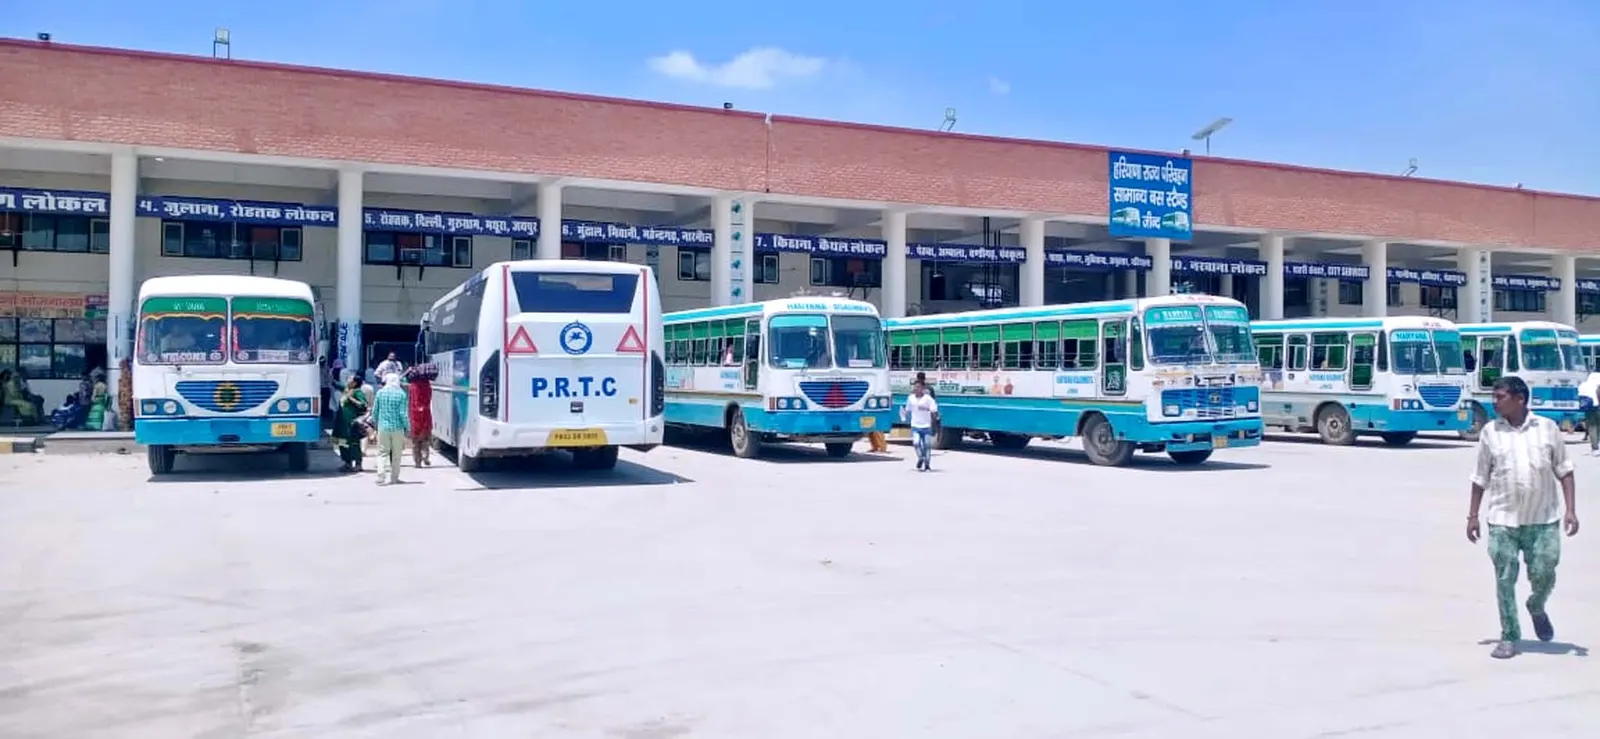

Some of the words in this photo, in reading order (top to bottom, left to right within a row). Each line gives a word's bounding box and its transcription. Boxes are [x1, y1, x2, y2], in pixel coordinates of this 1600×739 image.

[22, 191, 107, 212] लोकल
[1113, 187, 1148, 204] सामान्य
[1149, 190, 1165, 206] बस
[163, 200, 225, 218] जुलाना,
[230, 203, 281, 218] रोहतक
[284, 205, 335, 222] लोकल
[415, 212, 445, 230] दिल्ली,
[850, 241, 885, 255] लोकल
[1189, 260, 1229, 273] नरवाना
[1230, 261, 1266, 274] लोकल
